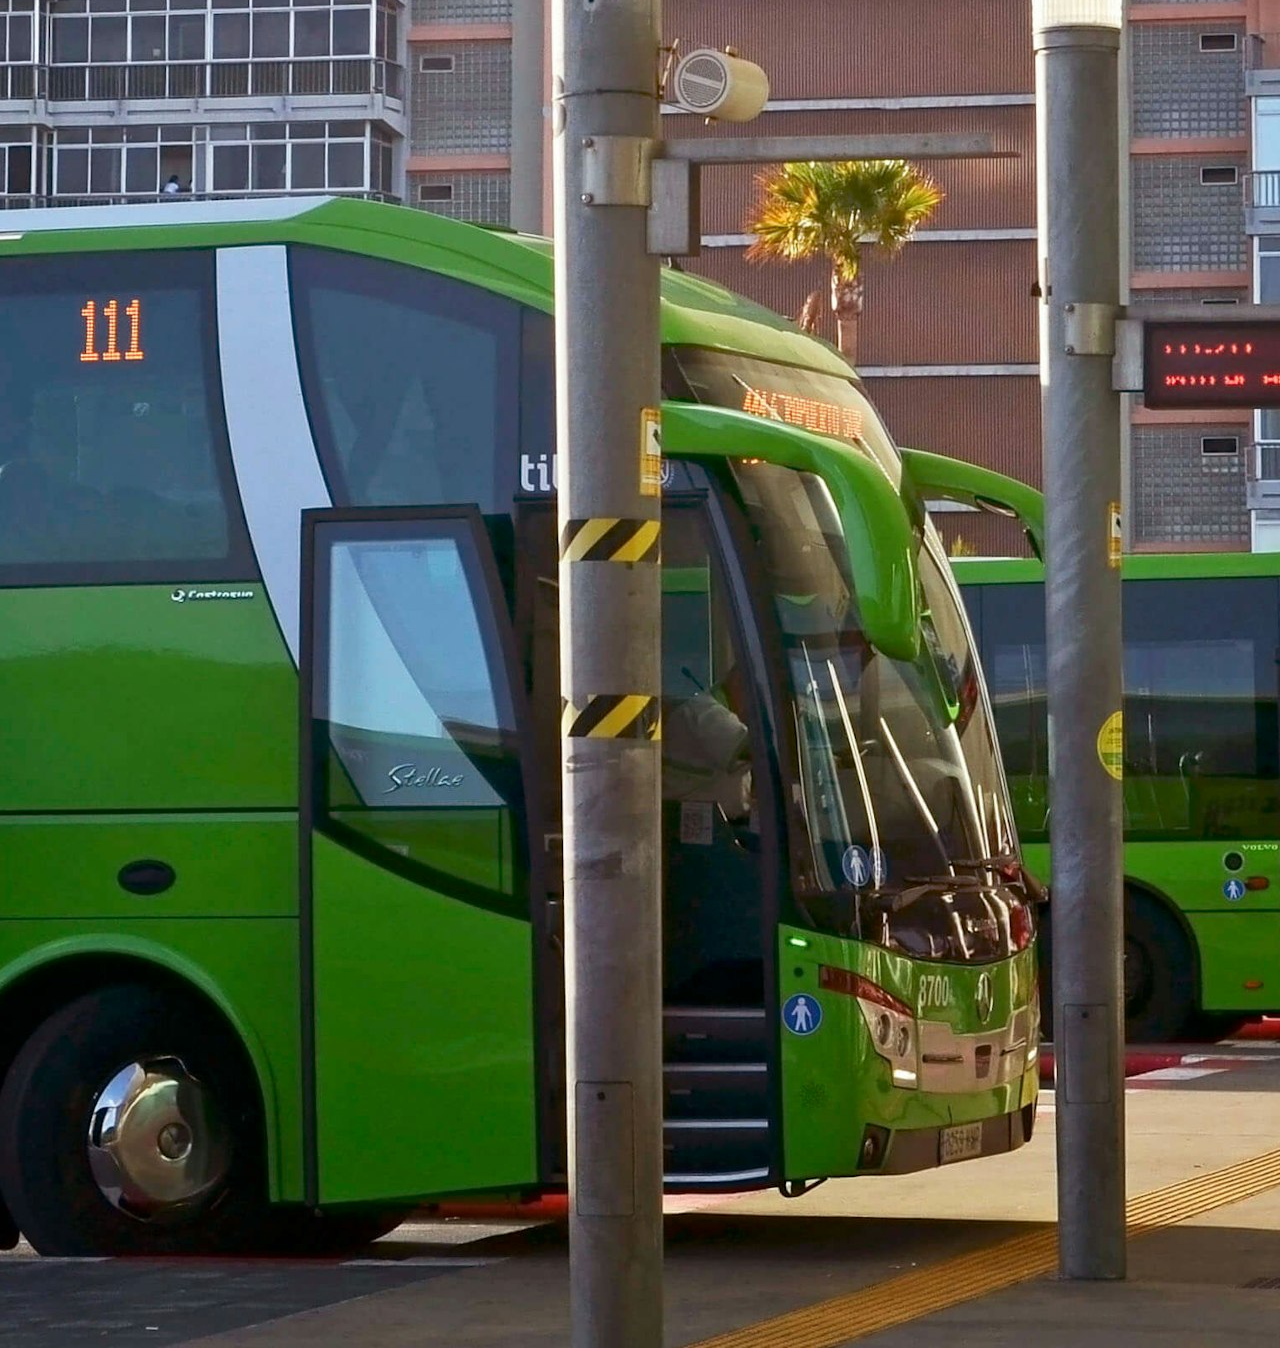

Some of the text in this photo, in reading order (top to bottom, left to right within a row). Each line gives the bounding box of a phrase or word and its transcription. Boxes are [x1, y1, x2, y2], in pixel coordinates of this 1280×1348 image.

[80, 299, 144, 361] 111
[521, 453, 559, 492] ti
[383, 763, 465, 794] Stellae
[919, 975, 949, 1007] 8700
